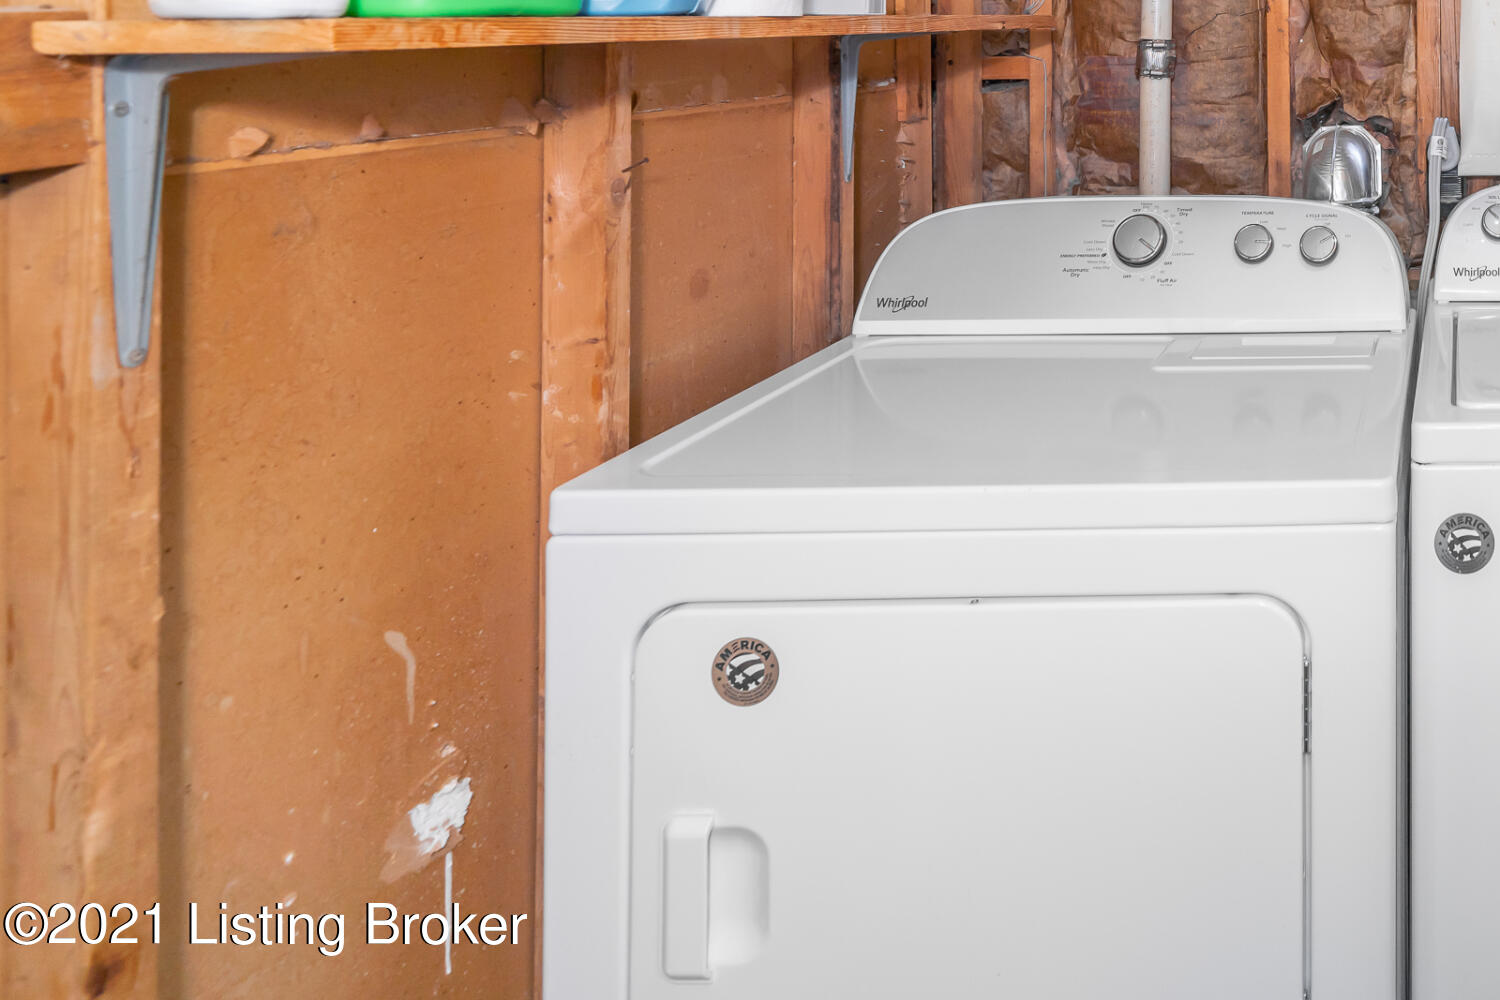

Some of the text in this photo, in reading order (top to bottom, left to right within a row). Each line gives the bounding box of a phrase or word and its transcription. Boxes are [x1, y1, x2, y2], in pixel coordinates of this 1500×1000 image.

[1453, 265, 1500, 282] Whirlpool
[876, 295, 929, 314] Whirlpool
[1439, 515, 1490, 540] AMERICA
[714, 639, 772, 672] AMERICA
